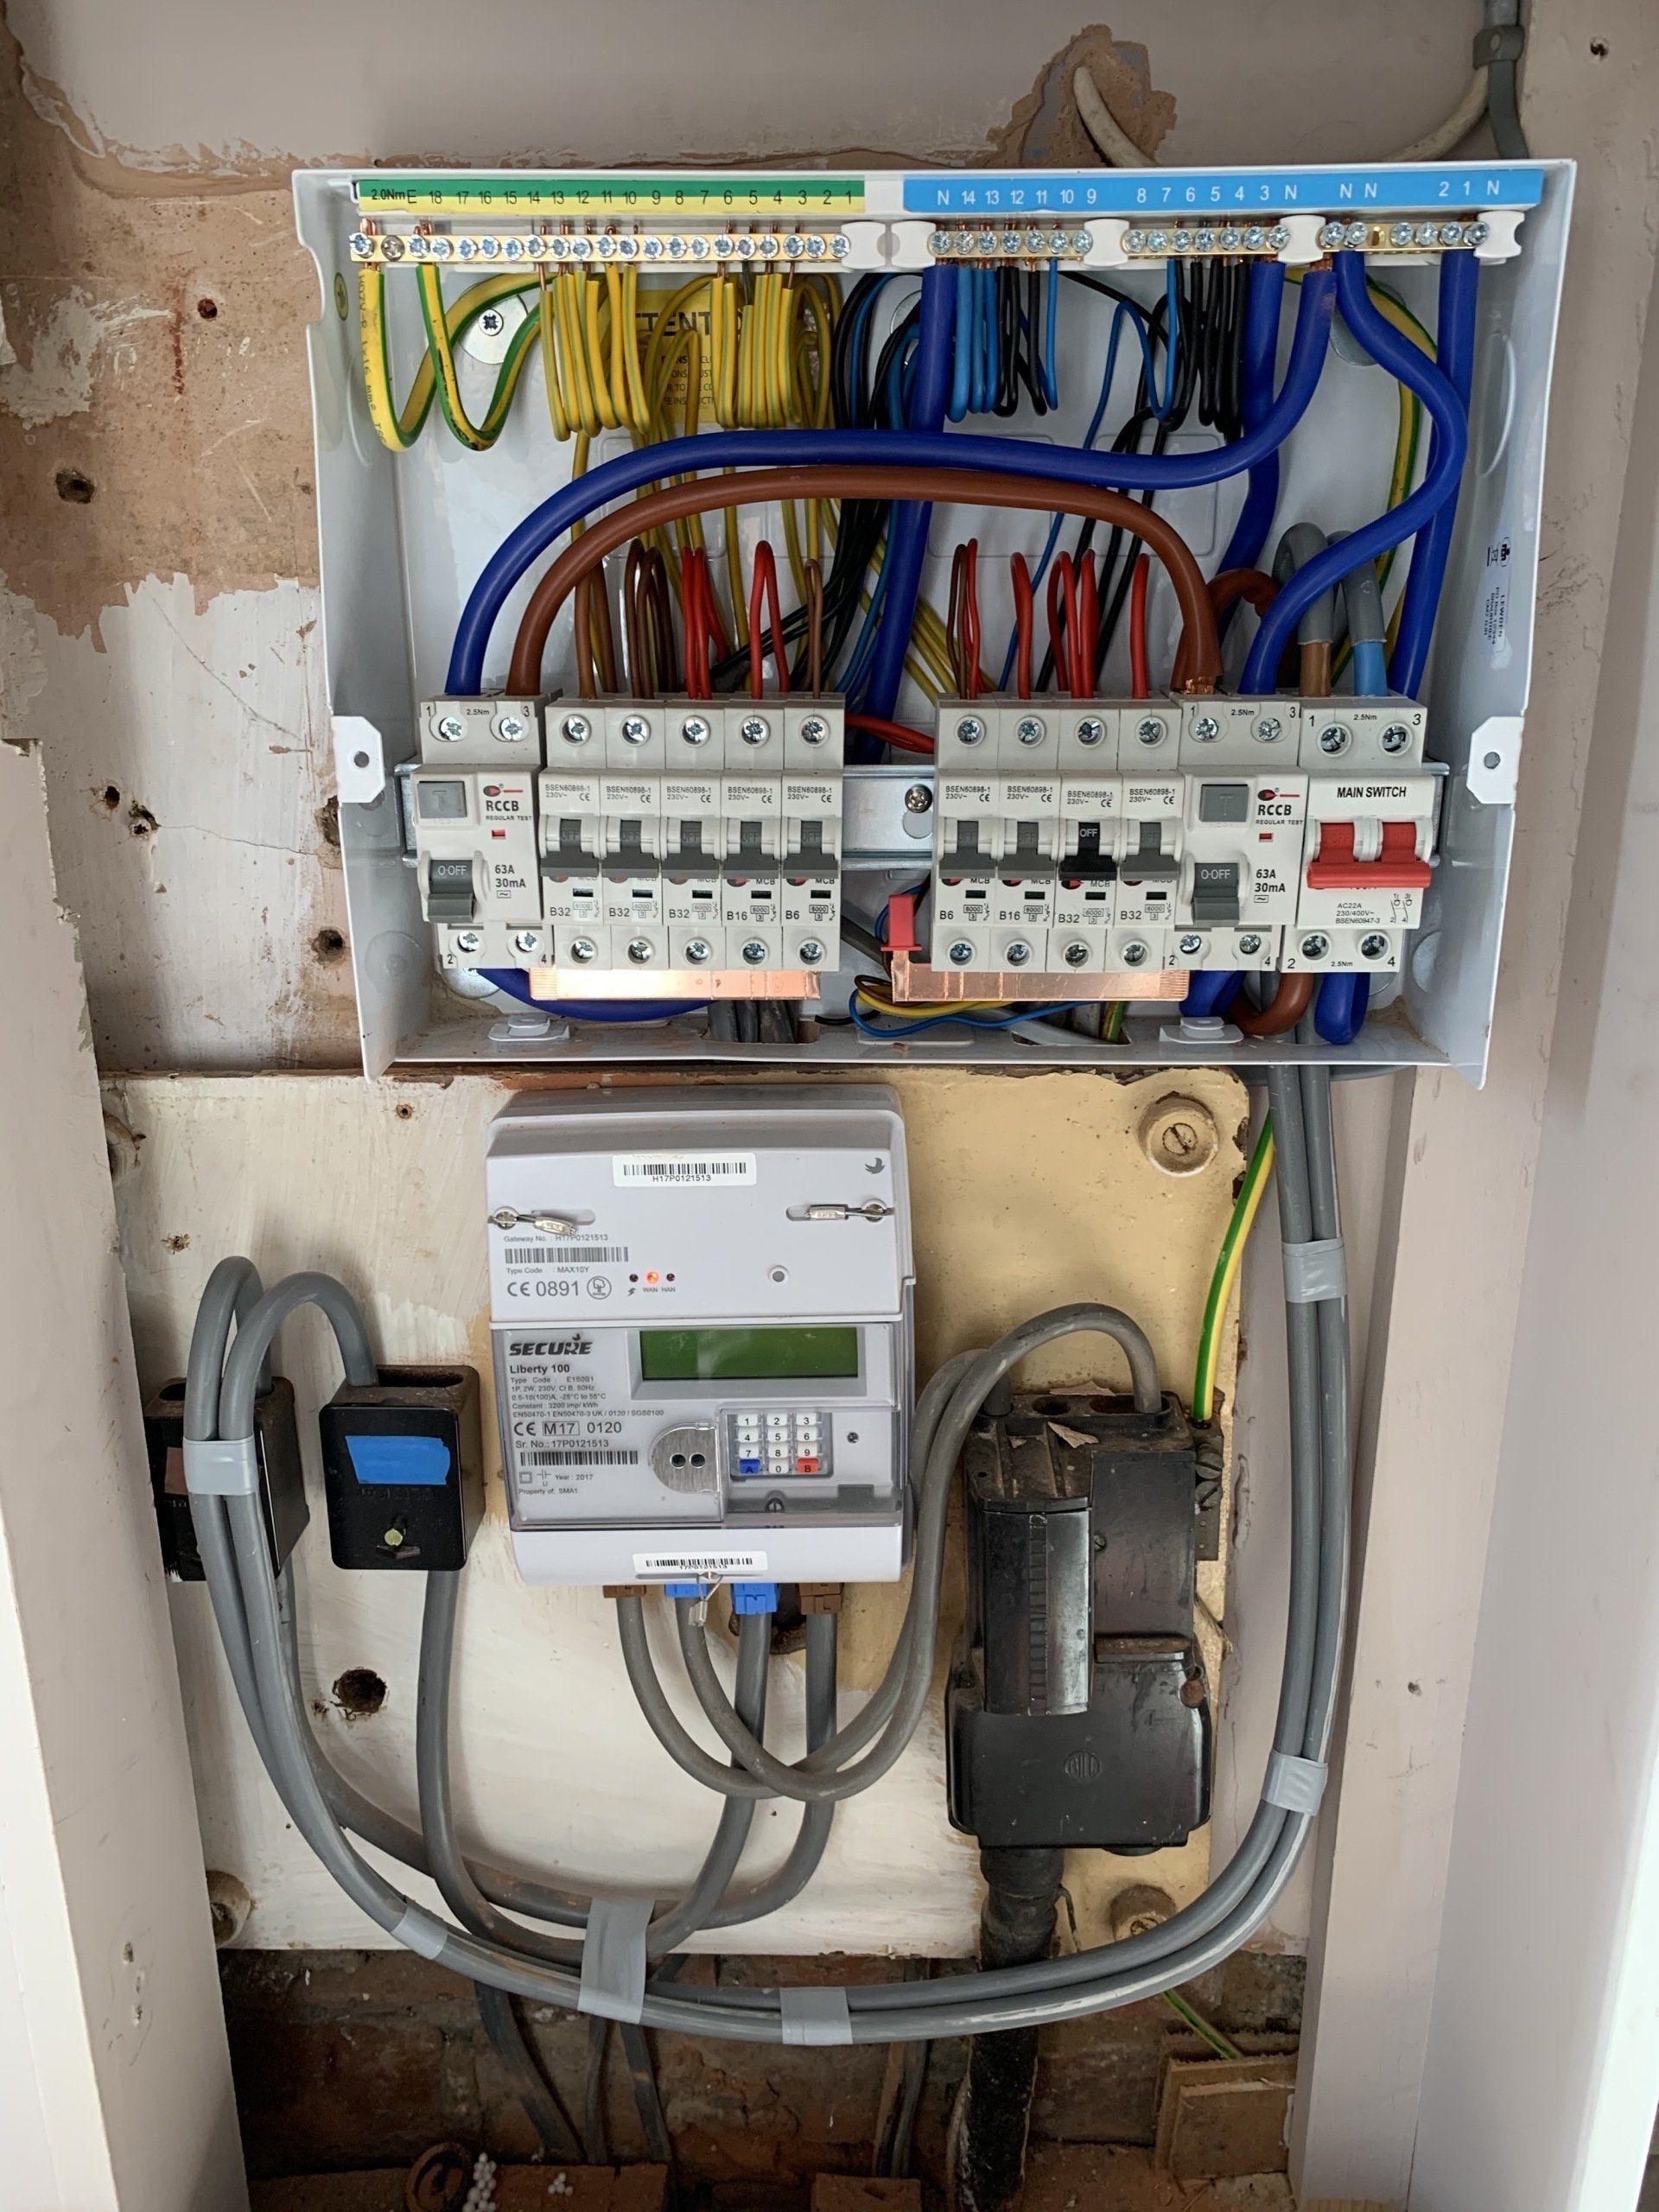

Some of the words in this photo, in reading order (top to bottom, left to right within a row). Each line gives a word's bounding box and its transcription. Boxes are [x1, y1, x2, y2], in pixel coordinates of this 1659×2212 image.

[372, 188, 405, 200] 2.0Nm
[407, 189, 416, 204] E
[429, 190, 442, 205] 18
[456, 190, 469, 205] 17
[479, 190, 492, 205] 16
[504, 190, 518, 205] 15
[527, 190, 540, 205] 14
[551, 190, 564, 205] 13
[578, 190, 590, 205] 12
[603, 190, 613, 205] 11
[623, 190, 637, 205] 10
[652, 190, 661, 205] 9
[675, 190, 683, 205] 8
[700, 190, 709, 205] 7
[723, 190, 733, 205] 6
[749, 190, 758, 205] 5
[773, 190, 782, 205] 4
[798, 190, 807, 205] 3
[823, 190, 832, 205] 2
[845, 190, 851, 205] 1
[938, 190, 950, 206] N
[961, 190, 976, 205] 14
[985, 190, 1000, 205] 13
[1010, 189, 1024, 205] 12
[1035, 189, 1047, 204] 11
[1060, 189, 1074, 204] 10
[1087, 188, 1096, 203] 9
[1136, 188, 1147, 202] 8
[1162, 188, 1172, 202] 7
[1185, 188, 1195, 202] 6
[1211, 187, 1220, 201] 5
[1235, 187, 1244, 200] 4
[1260, 186, 1269, 200] 3
[1285, 185, 1297, 200] N
[1340, 184, 1352, 198] N
[1365, 183, 1377, 198] N
[1439, 182, 1449, 196] 2
[1463, 181, 1469, 195] 1
[1487, 181, 1500, 195] N
[426, 706, 431, 717] 1
[523, 706, 530, 717] 3
[1191, 705, 1195, 716] 1
[1289, 707, 1296, 718] 3
[1309, 715, 1314, 727] 1
[1413, 714, 1421, 726] 3
[1337, 787, 1363, 798] MAIN
[1365, 786, 1407, 798] SWITCH
[486, 800, 518, 811] RCCB
[1258, 804, 1292, 816] RCCB
[1080, 829, 1097, 837] OFF
[495, 864, 515, 874] 63A
[1256, 869, 1276, 879] 63A
[495, 879, 526, 888] 30mA
[1255, 883, 1286, 893] 30mA
[550, 907, 571, 917] B32
[609, 908, 630, 917] B32
[669, 909, 690, 918] B32
[727, 912, 747, 920] B16
[785, 911, 800, 919] B6
[939, 911, 954, 919] B6
[999, 911, 1020, 920] B16
[1121, 911, 1141, 920] B32
[1058, 914, 1079, 923] B32
[447, 954, 454, 964] 2
[541, 954, 547, 963] 4
[1169, 955, 1175, 966] 2
[1264, 956, 1271, 967] 4
[1287, 958, 1296, 969] 2
[1388, 957, 1395, 967] 4
[507, 1281, 530, 1297] CE
[536, 1281, 579, 1297] 0891
[509, 1340, 593, 1356] SECURE
[510, 1364, 548, 1375] Liberty
[551, 1364, 570, 1373] 100
[514, 1422, 537, 1436] CE
[587, 1421, 622, 1433] 0120
